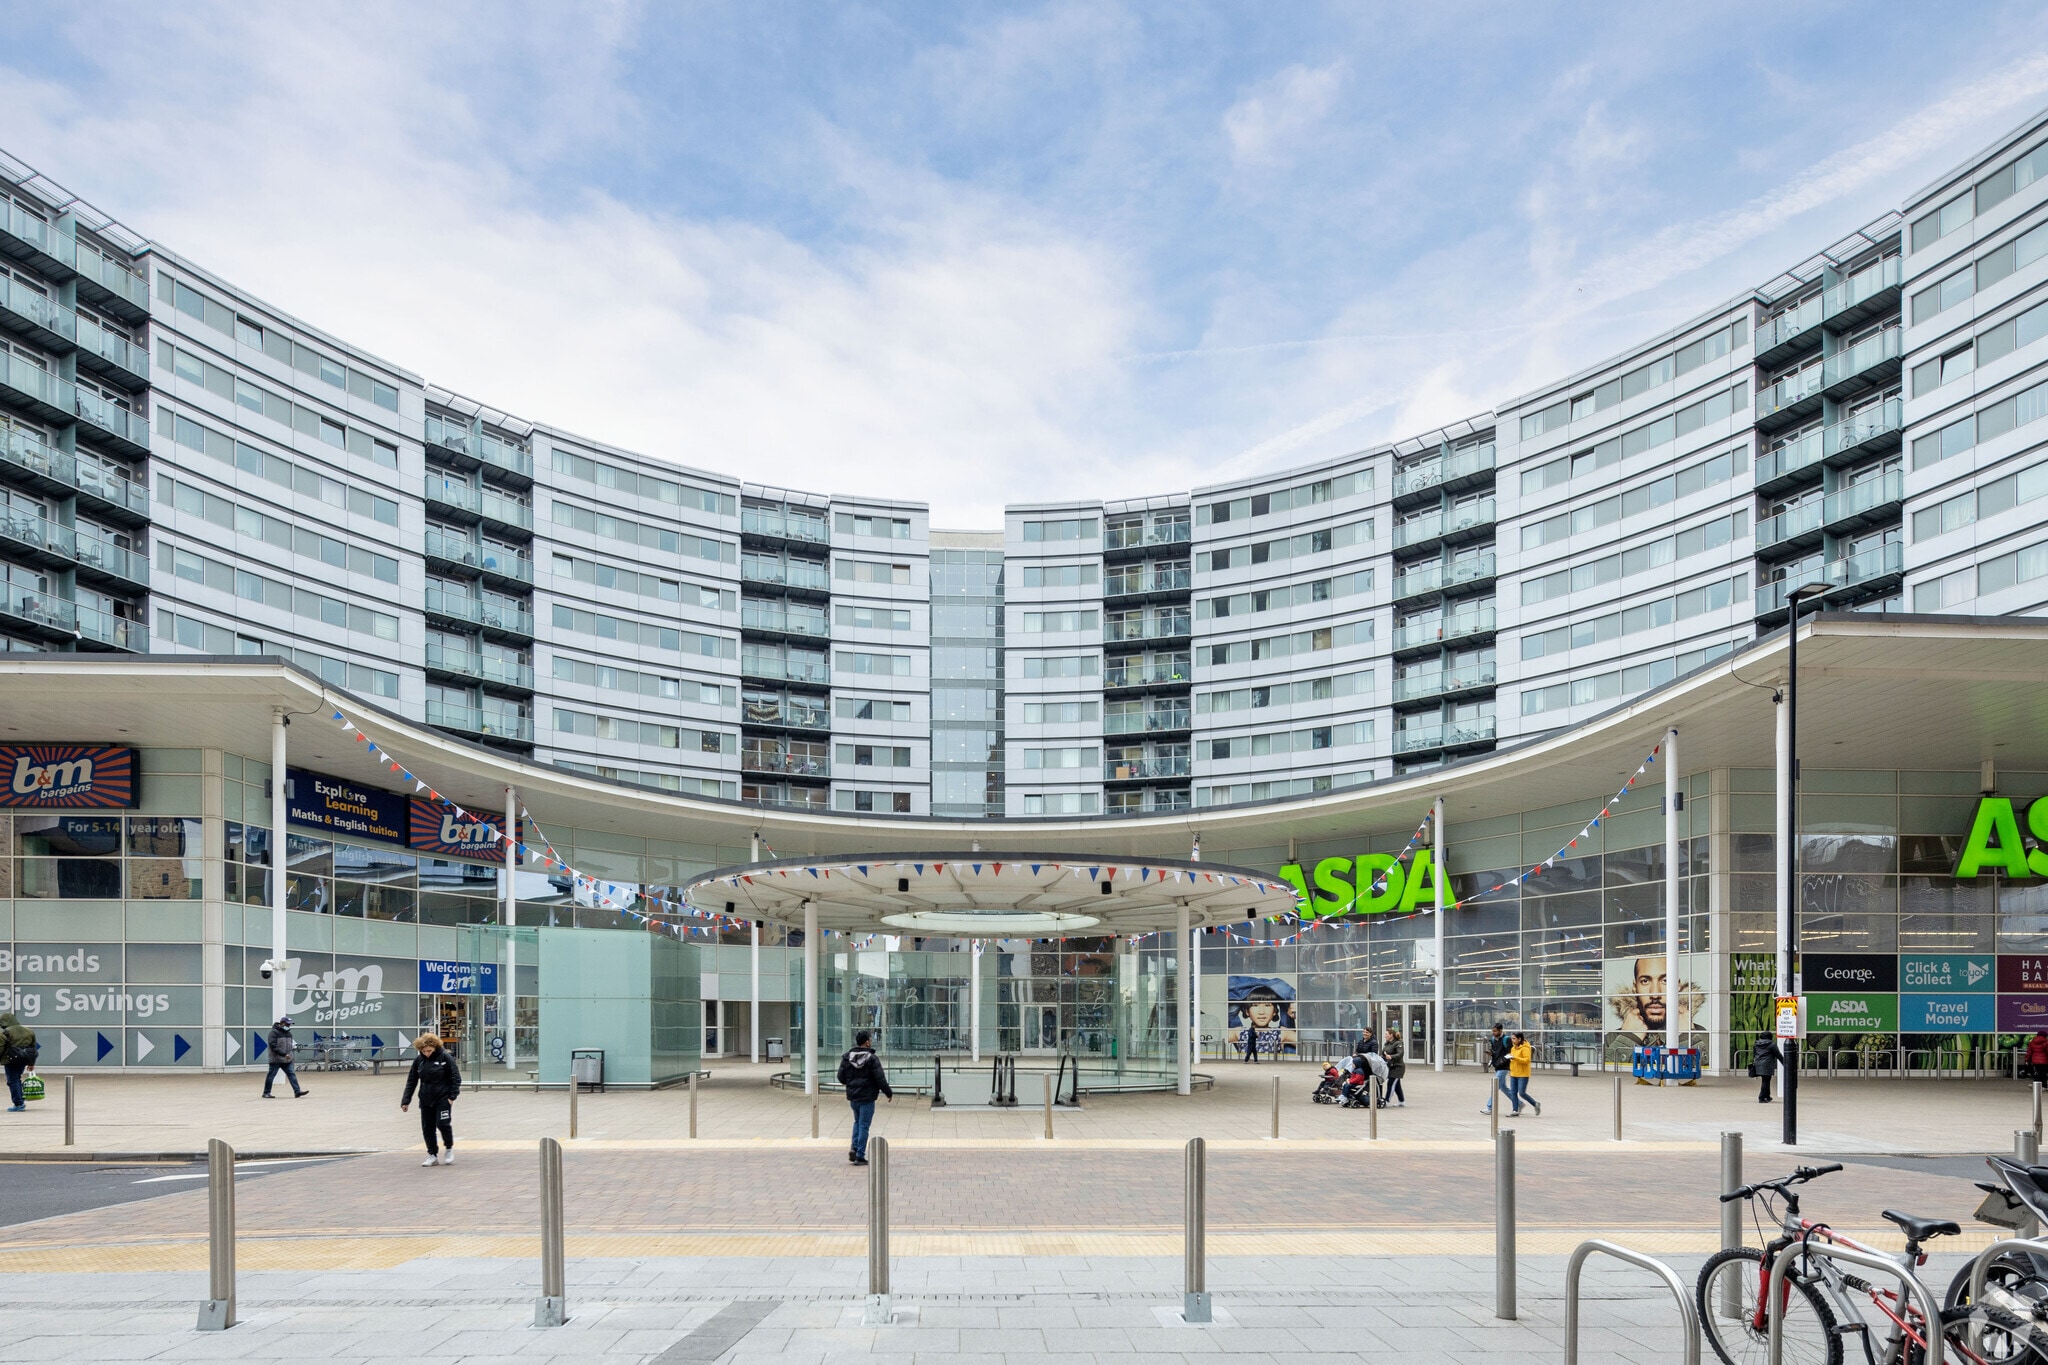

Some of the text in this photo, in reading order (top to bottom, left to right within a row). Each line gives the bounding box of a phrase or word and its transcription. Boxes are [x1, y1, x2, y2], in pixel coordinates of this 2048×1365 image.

[13, 757, 94, 794] b&m
[40, 783, 92, 799] bargains
[314, 781, 367, 803] Explore
[326, 796, 378, 821] Learning
[68, 821, 187, 835] For 5-14 year olds
[292, 807, 398, 838] Maths & English tuition
[440, 814, 497, 844] b&m
[460, 841, 497, 851] bargains
[335, 848, 373, 864] English
[1264, 848, 1457, 922] ASDA
[0, 948, 100, 973] Brands
[425, 962, 492, 975] Welcome to
[1905, 962, 1951, 973] Click &
[2022, 960, 2048, 970] HA
[282, 957, 385, 1015] b&m
[441, 973, 477, 992] b&m
[1734, 974, 1746, 986] in
[1905, 974, 1952, 985] Collect
[0, 987, 170, 1018] Big Savings
[1830, 1000, 1869, 1013] ASDA
[1927, 1001, 1968, 1013] Travel
[2020, 1002, 2047, 1013] Cake
[315, 1001, 383, 1023] bargains
[1925, 1013, 1969, 1027] Money
[1816, 1015, 1882, 1029] Pharmacy
